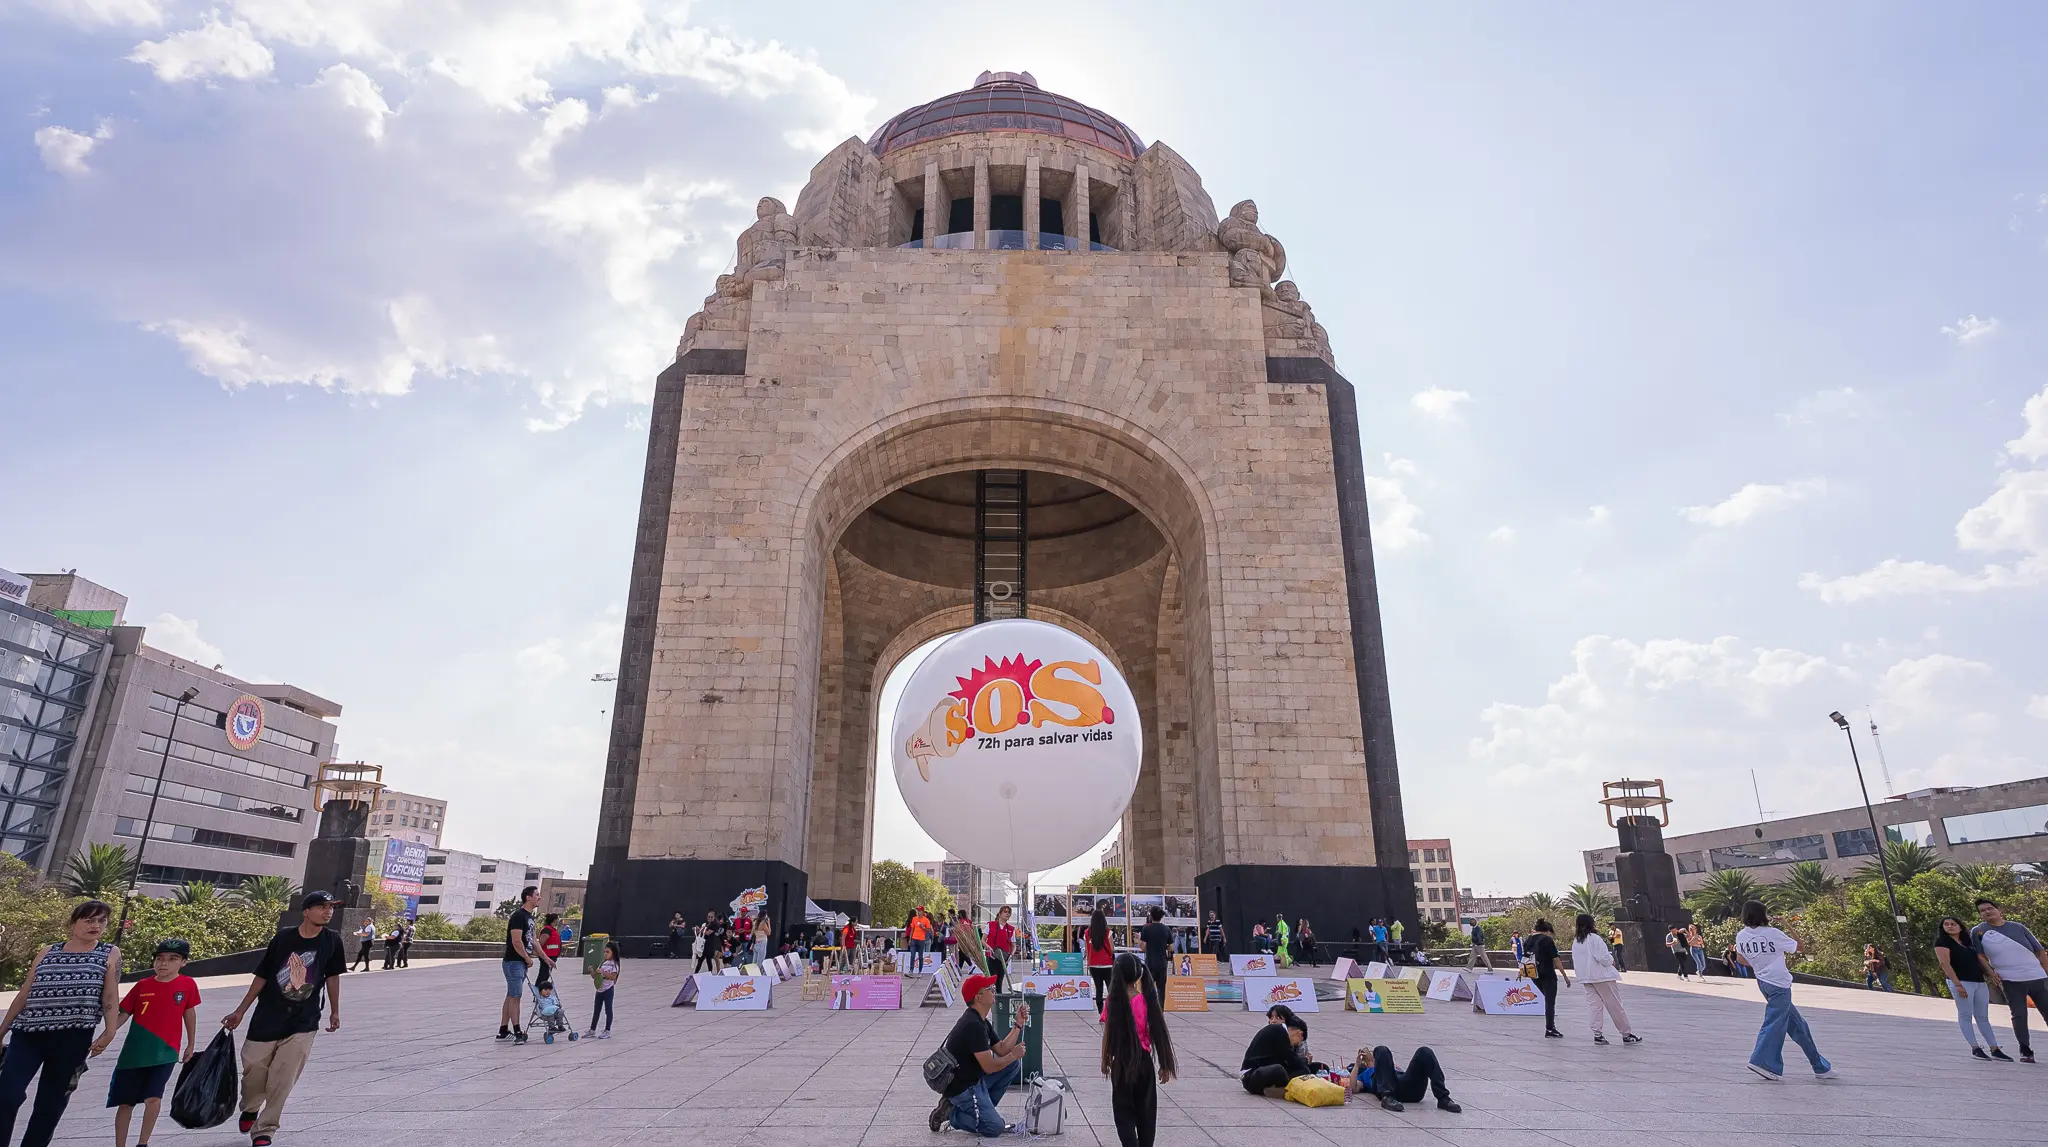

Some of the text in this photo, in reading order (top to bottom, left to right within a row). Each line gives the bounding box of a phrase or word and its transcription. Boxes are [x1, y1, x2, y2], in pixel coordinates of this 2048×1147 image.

[946, 658, 1115, 747] S.O.S.
[978, 729, 1113, 751] 72h para salvar vidas
[404, 847, 426, 859] RENTA
[397, 856, 425, 867] COWORKING
[386, 862, 424, 877] Y OFICINAS
[140, 1001, 150, 1015] 7
